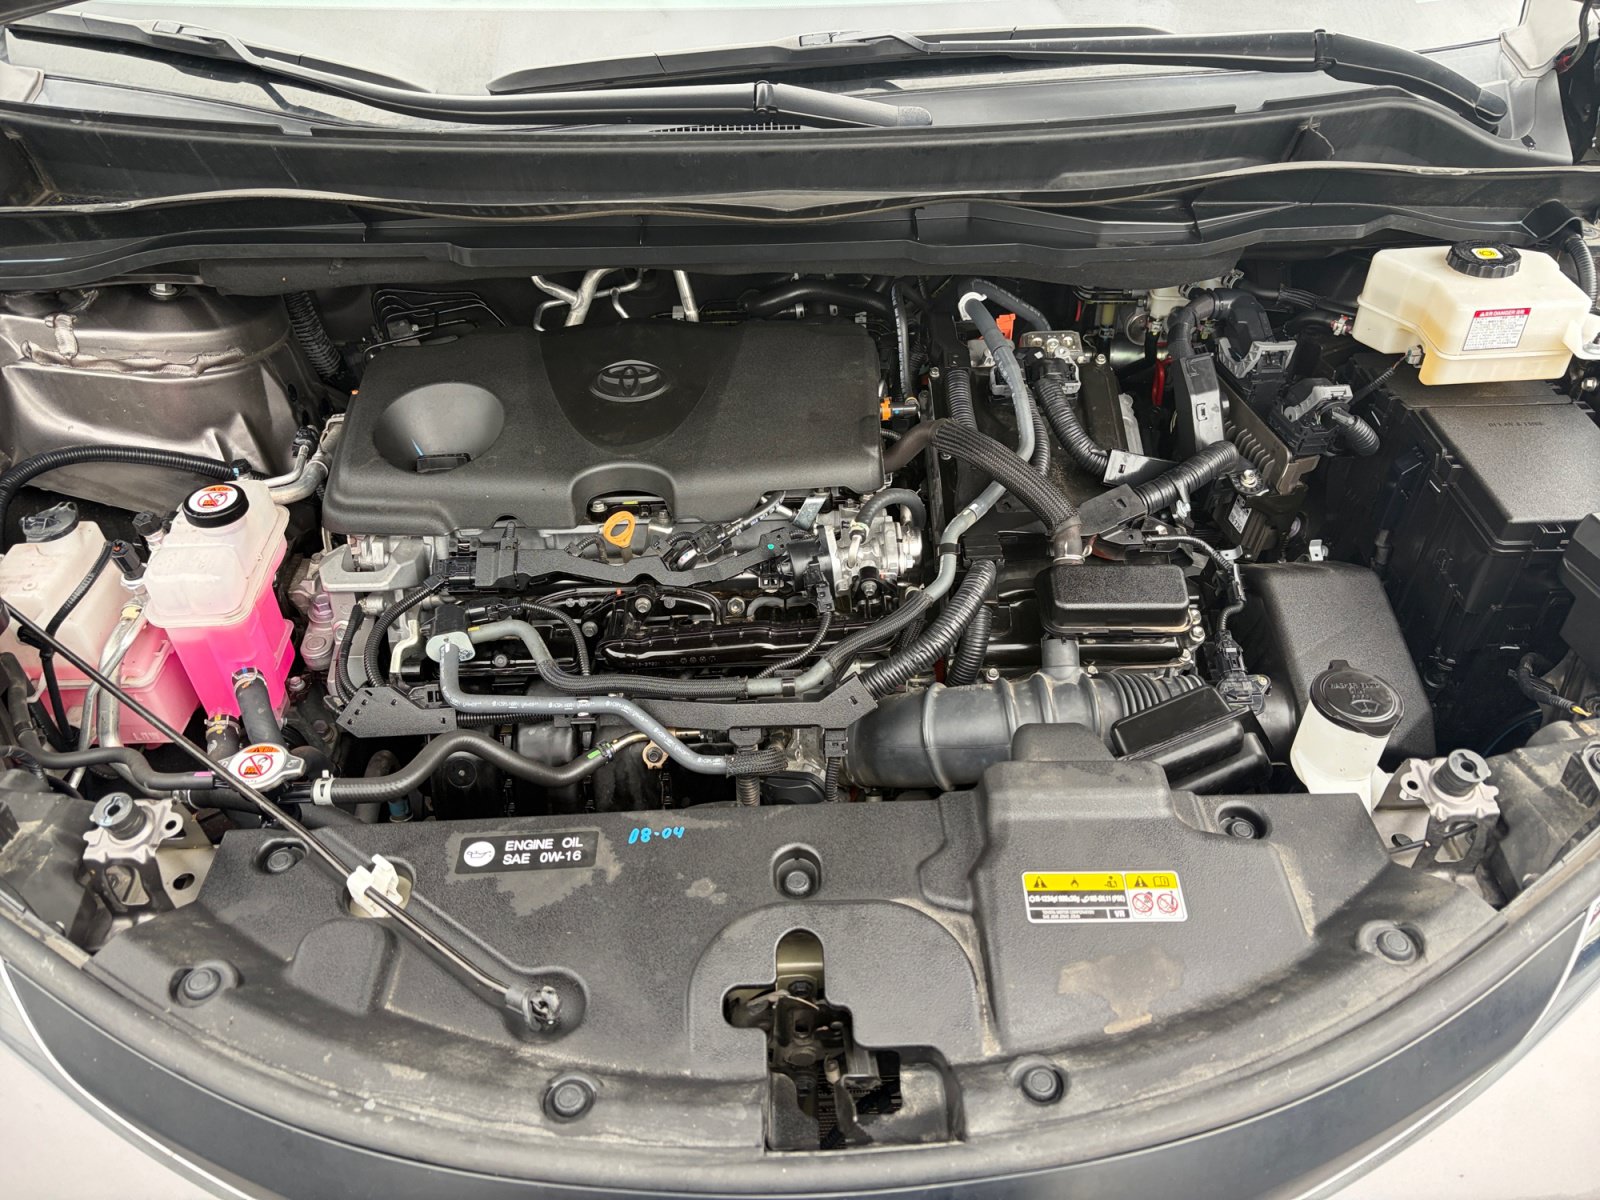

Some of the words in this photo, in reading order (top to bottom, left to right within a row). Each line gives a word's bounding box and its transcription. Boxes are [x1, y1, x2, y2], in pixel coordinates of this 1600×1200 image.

[504, 838, 555, 852] ENGINE
[561, 837, 583, 849] OIL
[502, 853, 531, 866] SAE
[539, 850, 582, 864] 0W-16
